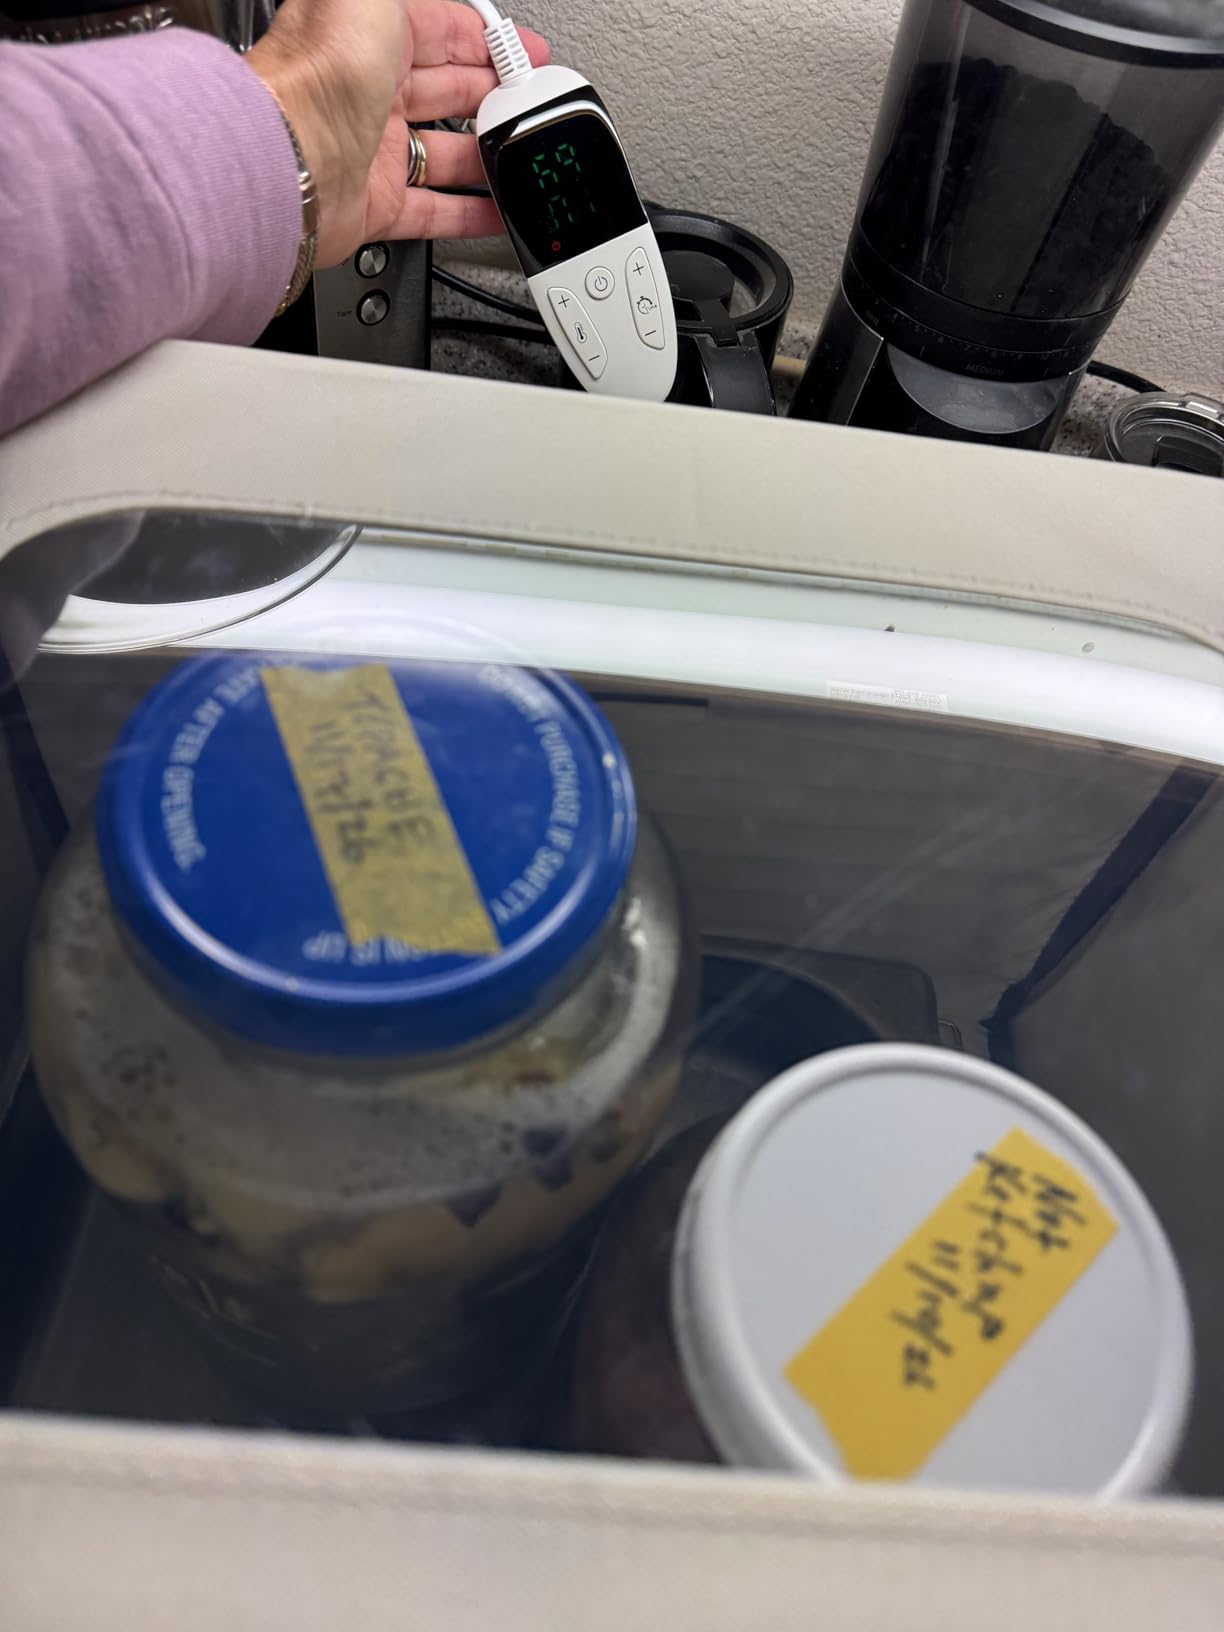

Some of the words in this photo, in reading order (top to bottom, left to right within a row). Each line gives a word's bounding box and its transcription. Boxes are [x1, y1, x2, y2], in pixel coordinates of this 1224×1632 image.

[168, 697, 225, 765] AFTER
[534, 719, 581, 827] PURCHASE
[546, 825, 574, 851] IF
[490, 846, 565, 926] SAFETY
